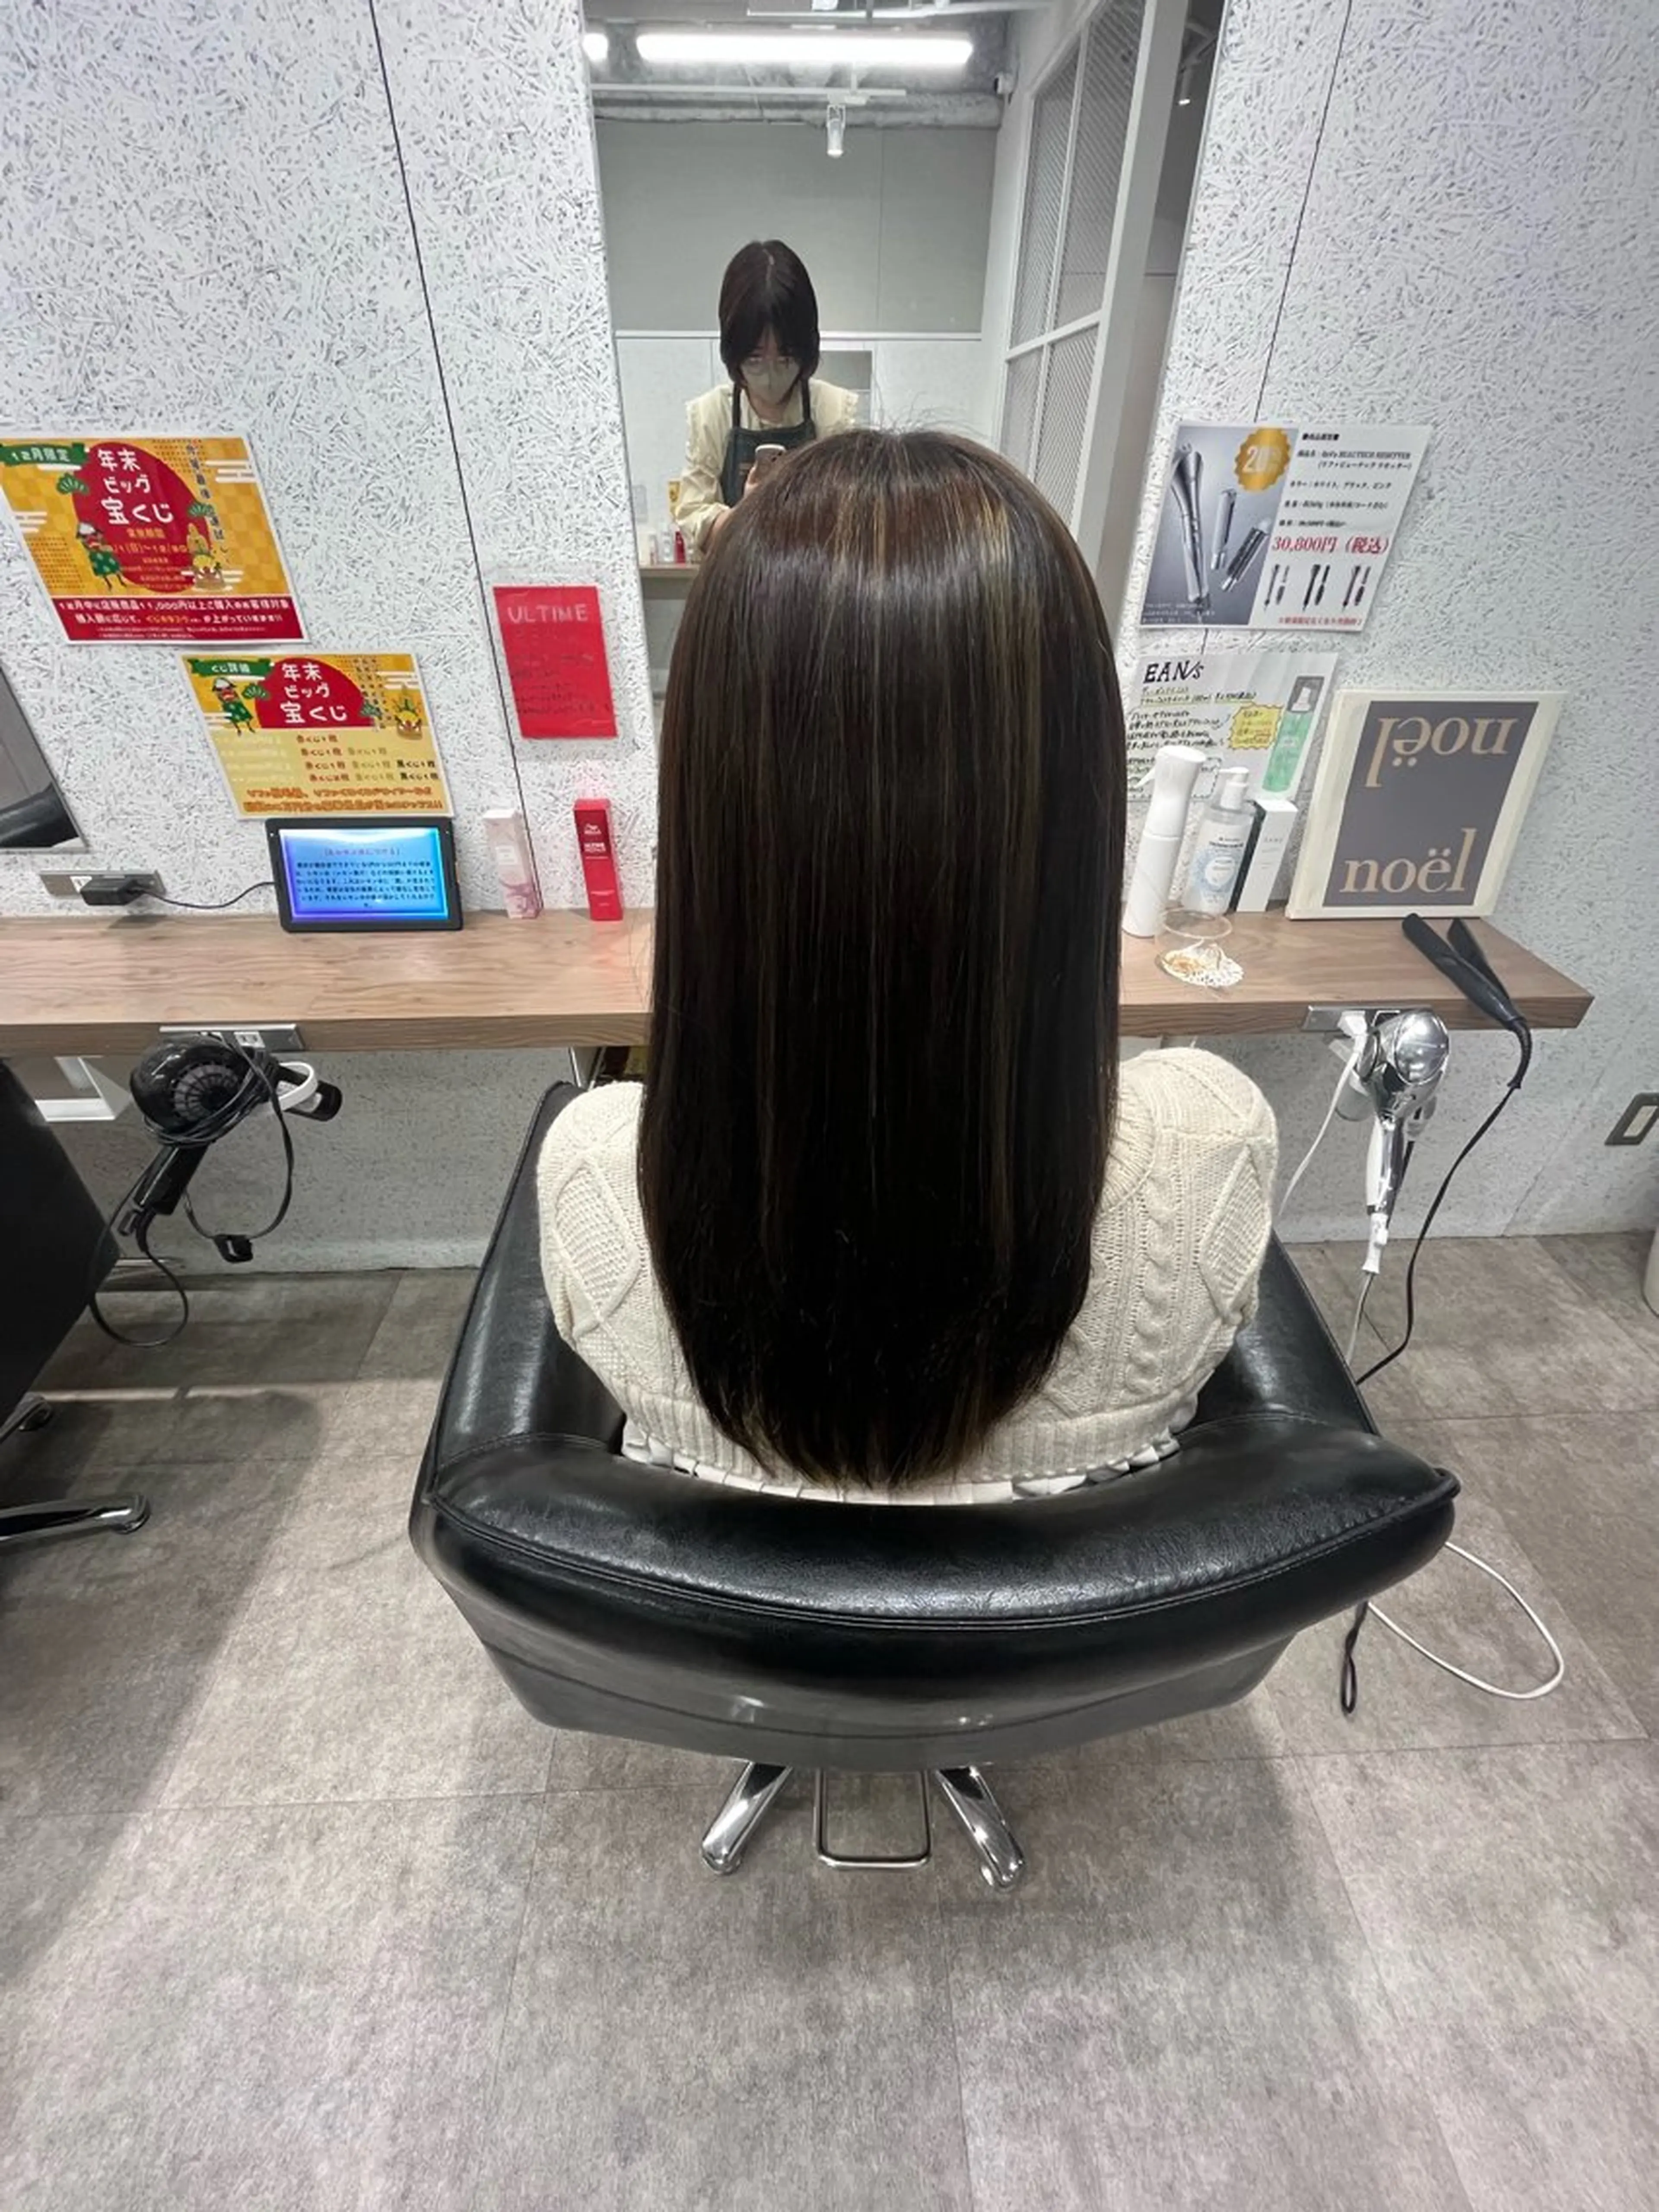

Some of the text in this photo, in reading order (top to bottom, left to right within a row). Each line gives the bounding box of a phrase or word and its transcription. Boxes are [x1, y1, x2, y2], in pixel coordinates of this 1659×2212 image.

[97, 449, 142, 471] 年末
[104, 474, 151, 493] ビッグ
[100, 496, 174, 526] 宝くじ
[282, 662, 323, 681] 年末
[284, 683, 331, 699] ビッグ
[280, 701, 348, 724] 宝くじ
[1338, 827, 1478, 894] noël
